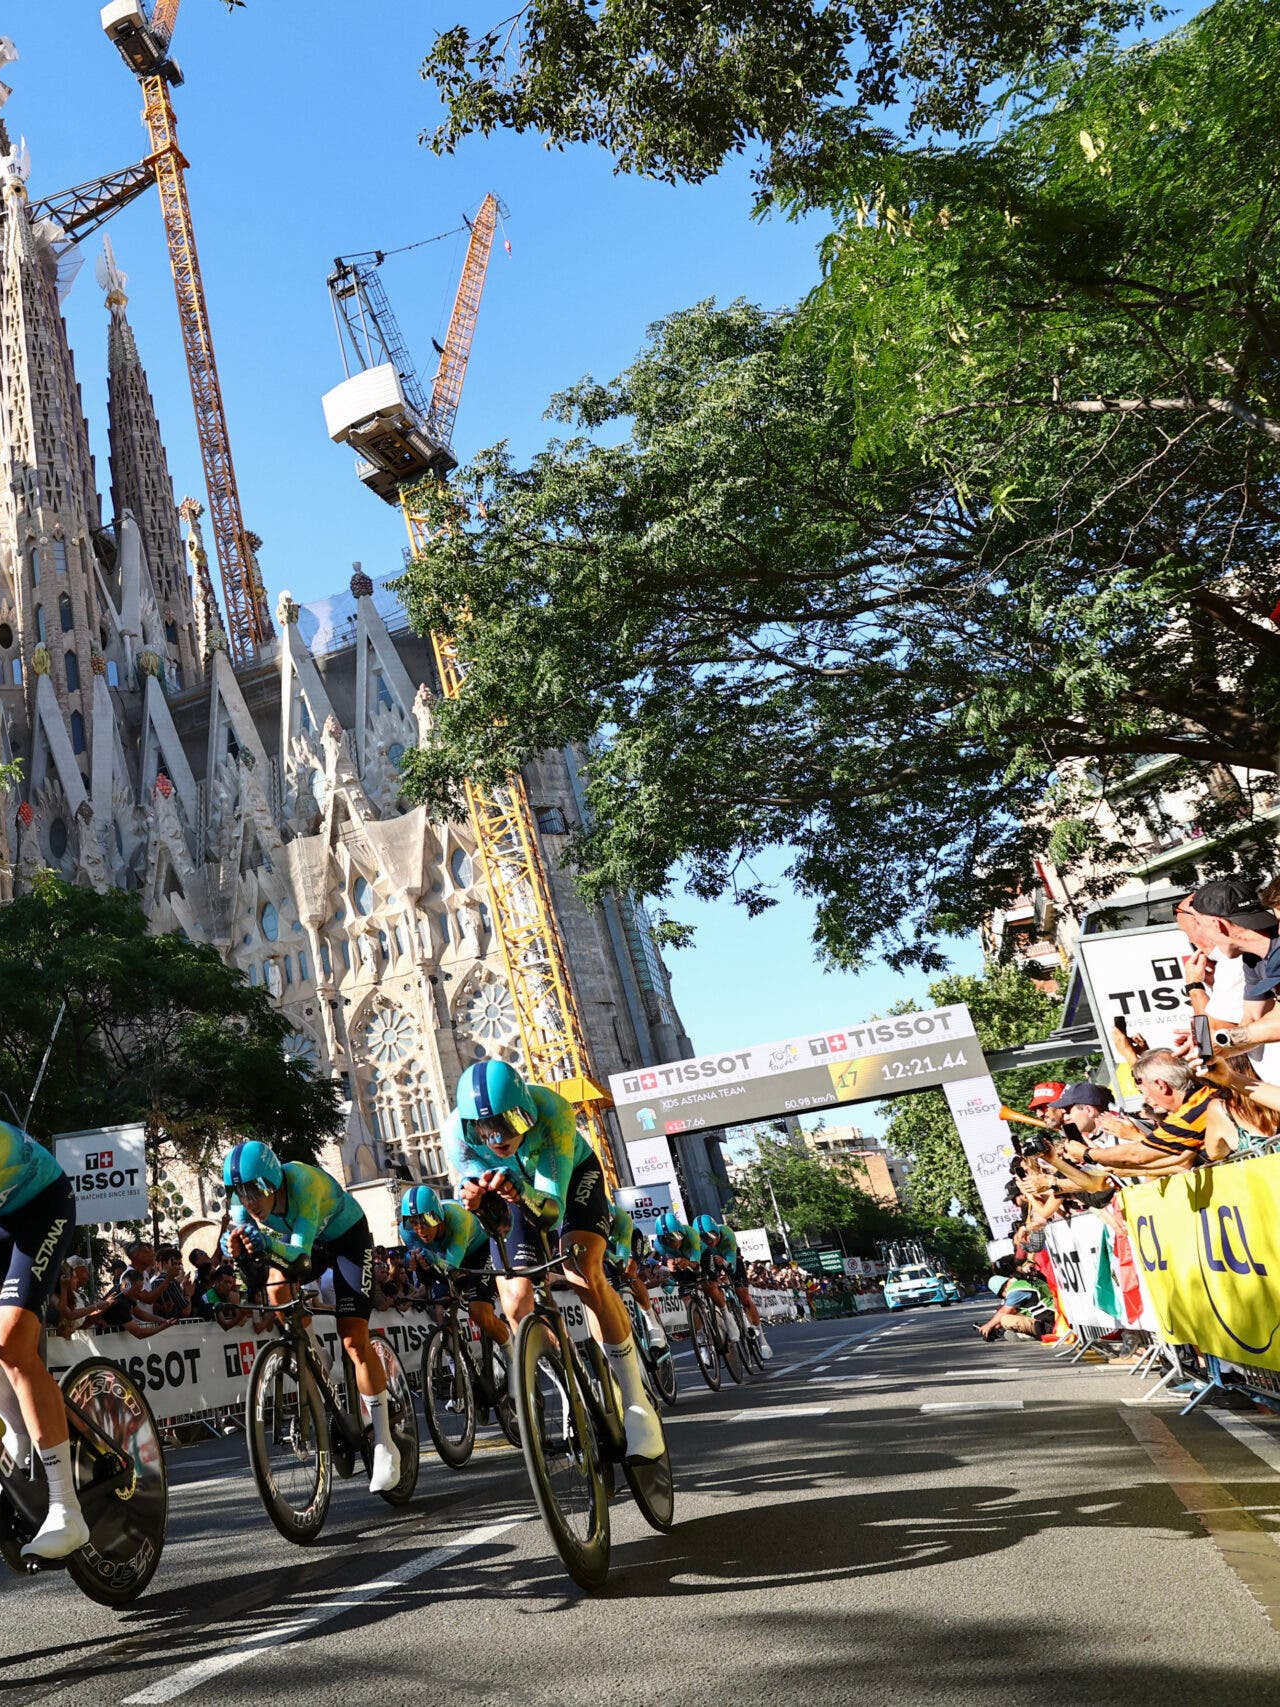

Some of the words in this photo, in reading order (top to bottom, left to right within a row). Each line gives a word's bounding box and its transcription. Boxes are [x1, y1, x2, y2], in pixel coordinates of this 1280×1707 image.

[847, 1011, 952, 1048] TISSOT
[658, 1052, 752, 1086] TISSOT
[837, 1071, 858, 1089] 17
[880, 1049, 969, 1081] 12:21.44
[680, 1091, 718, 1106] ASTANA
[717, 1085, 746, 1098] TEAM
[812, 1092, 836, 1106] km/h
[956, 1103, 997, 1117] TISSOT
[635, 1161, 669, 1175] TISSOT
[992, 1213, 1020, 1224] TISS
[30, 1218, 68, 1281] ASTANA
[742, 1243, 765, 1253] SSOT
[1136, 1214, 1168, 1273] CL
[1199, 1205, 1268, 1277] LCL
[361, 1248, 373, 1298] ASTANA
[387, 1323, 438, 1354] TISS
